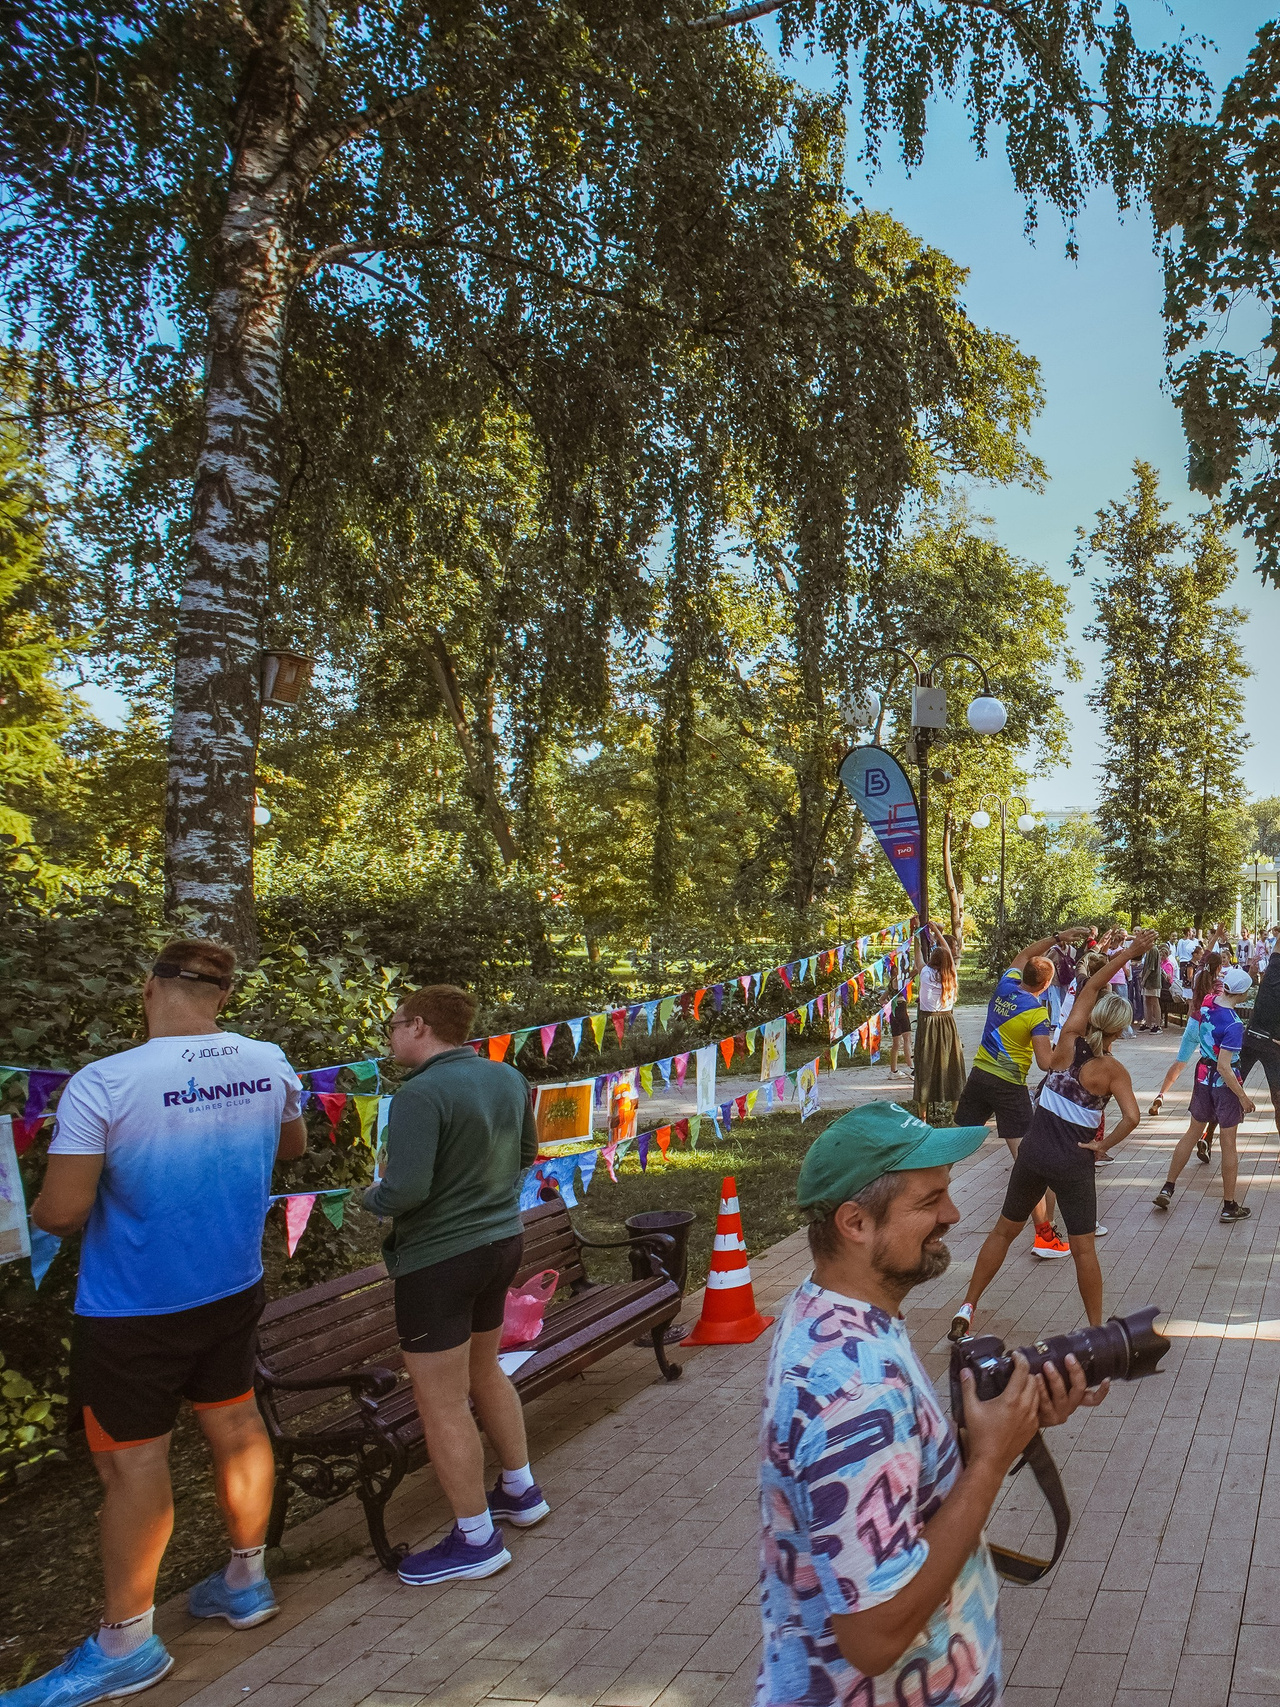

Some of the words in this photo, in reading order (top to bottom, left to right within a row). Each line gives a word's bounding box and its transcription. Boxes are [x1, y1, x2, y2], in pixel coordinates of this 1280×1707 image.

[163, 1077, 272, 1107] RUNNING
[188, 1102, 223, 1113] BAIRES
[226, 1098, 251, 1107] CLUB
